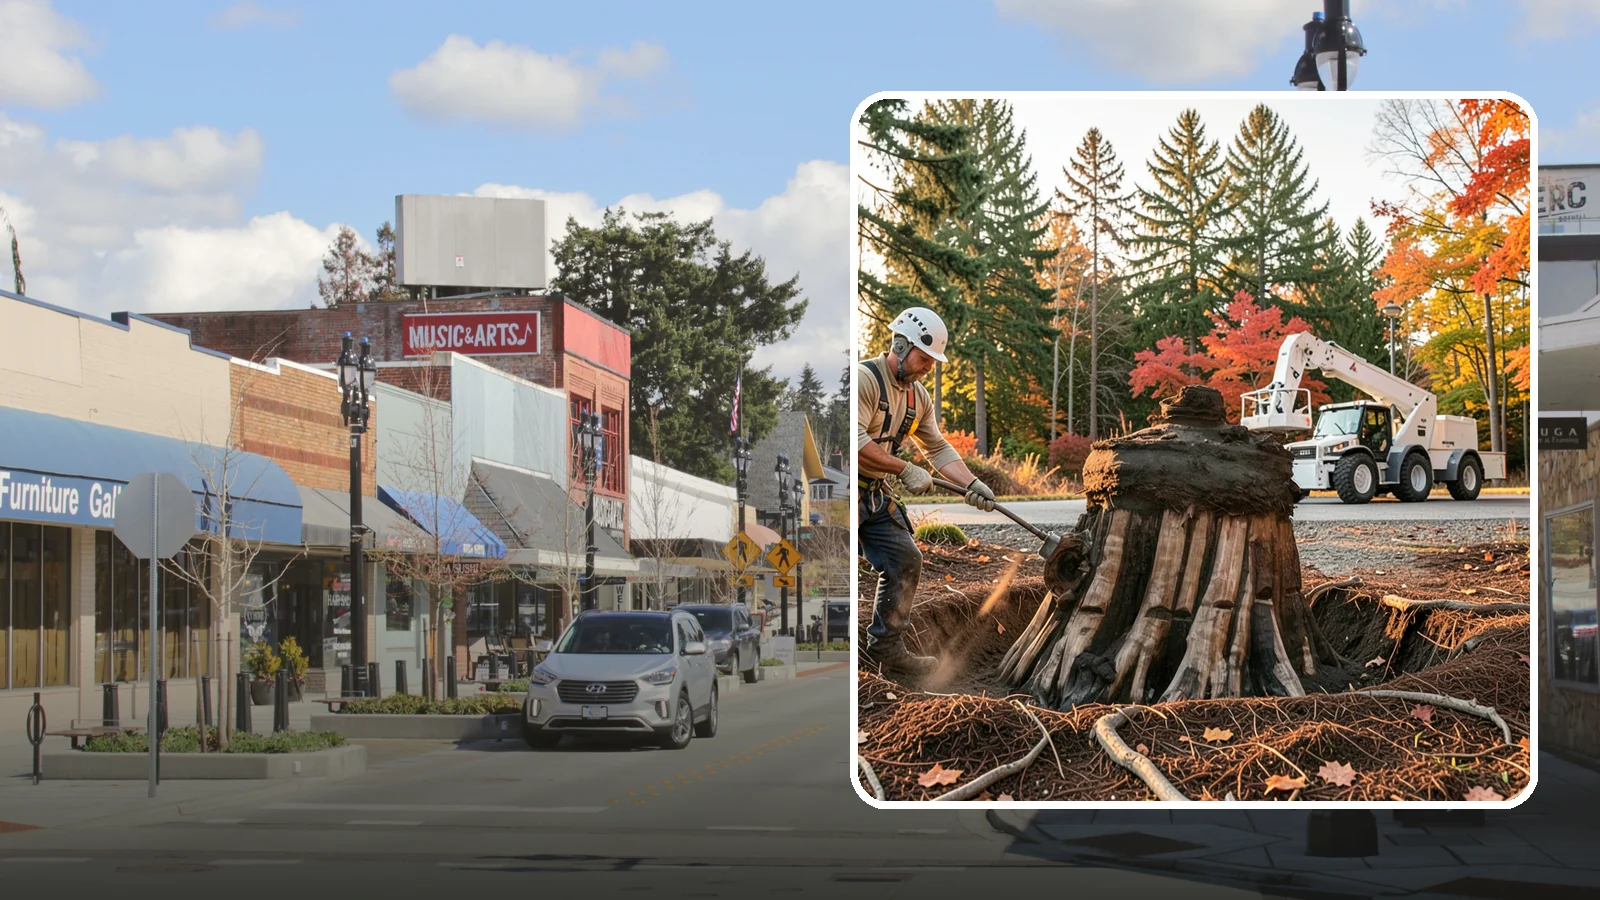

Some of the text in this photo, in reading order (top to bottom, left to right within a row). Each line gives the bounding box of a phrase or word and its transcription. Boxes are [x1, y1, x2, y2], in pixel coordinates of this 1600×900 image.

[408, 322, 520, 349] MUSIC&ARTS
[0, 471, 122, 519] Furniture Gal
[453, 563, 479, 575] SUSHI
